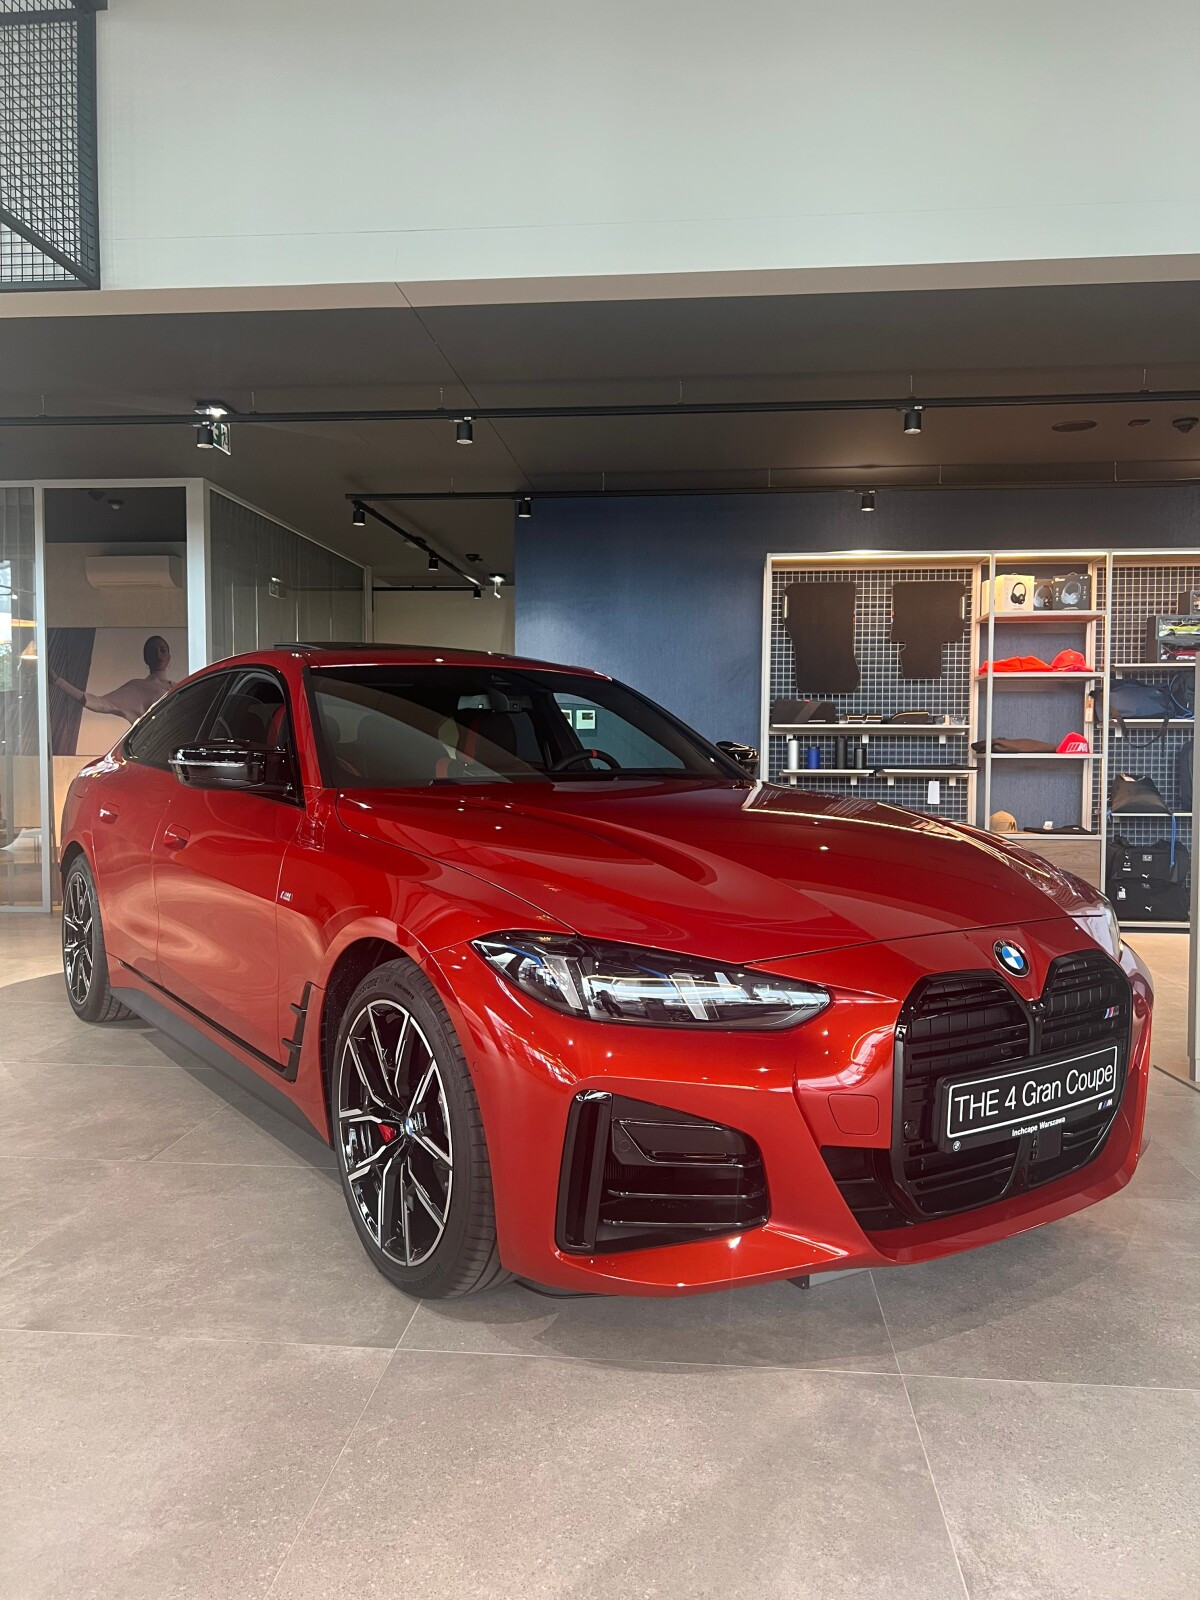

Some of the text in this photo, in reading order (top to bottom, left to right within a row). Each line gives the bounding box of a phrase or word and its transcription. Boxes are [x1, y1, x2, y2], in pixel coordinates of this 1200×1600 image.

[954, 1064, 1113, 1122] THE 4 Gran Coupe
[1011, 1116, 1066, 1137] Inchcape Warszawa
